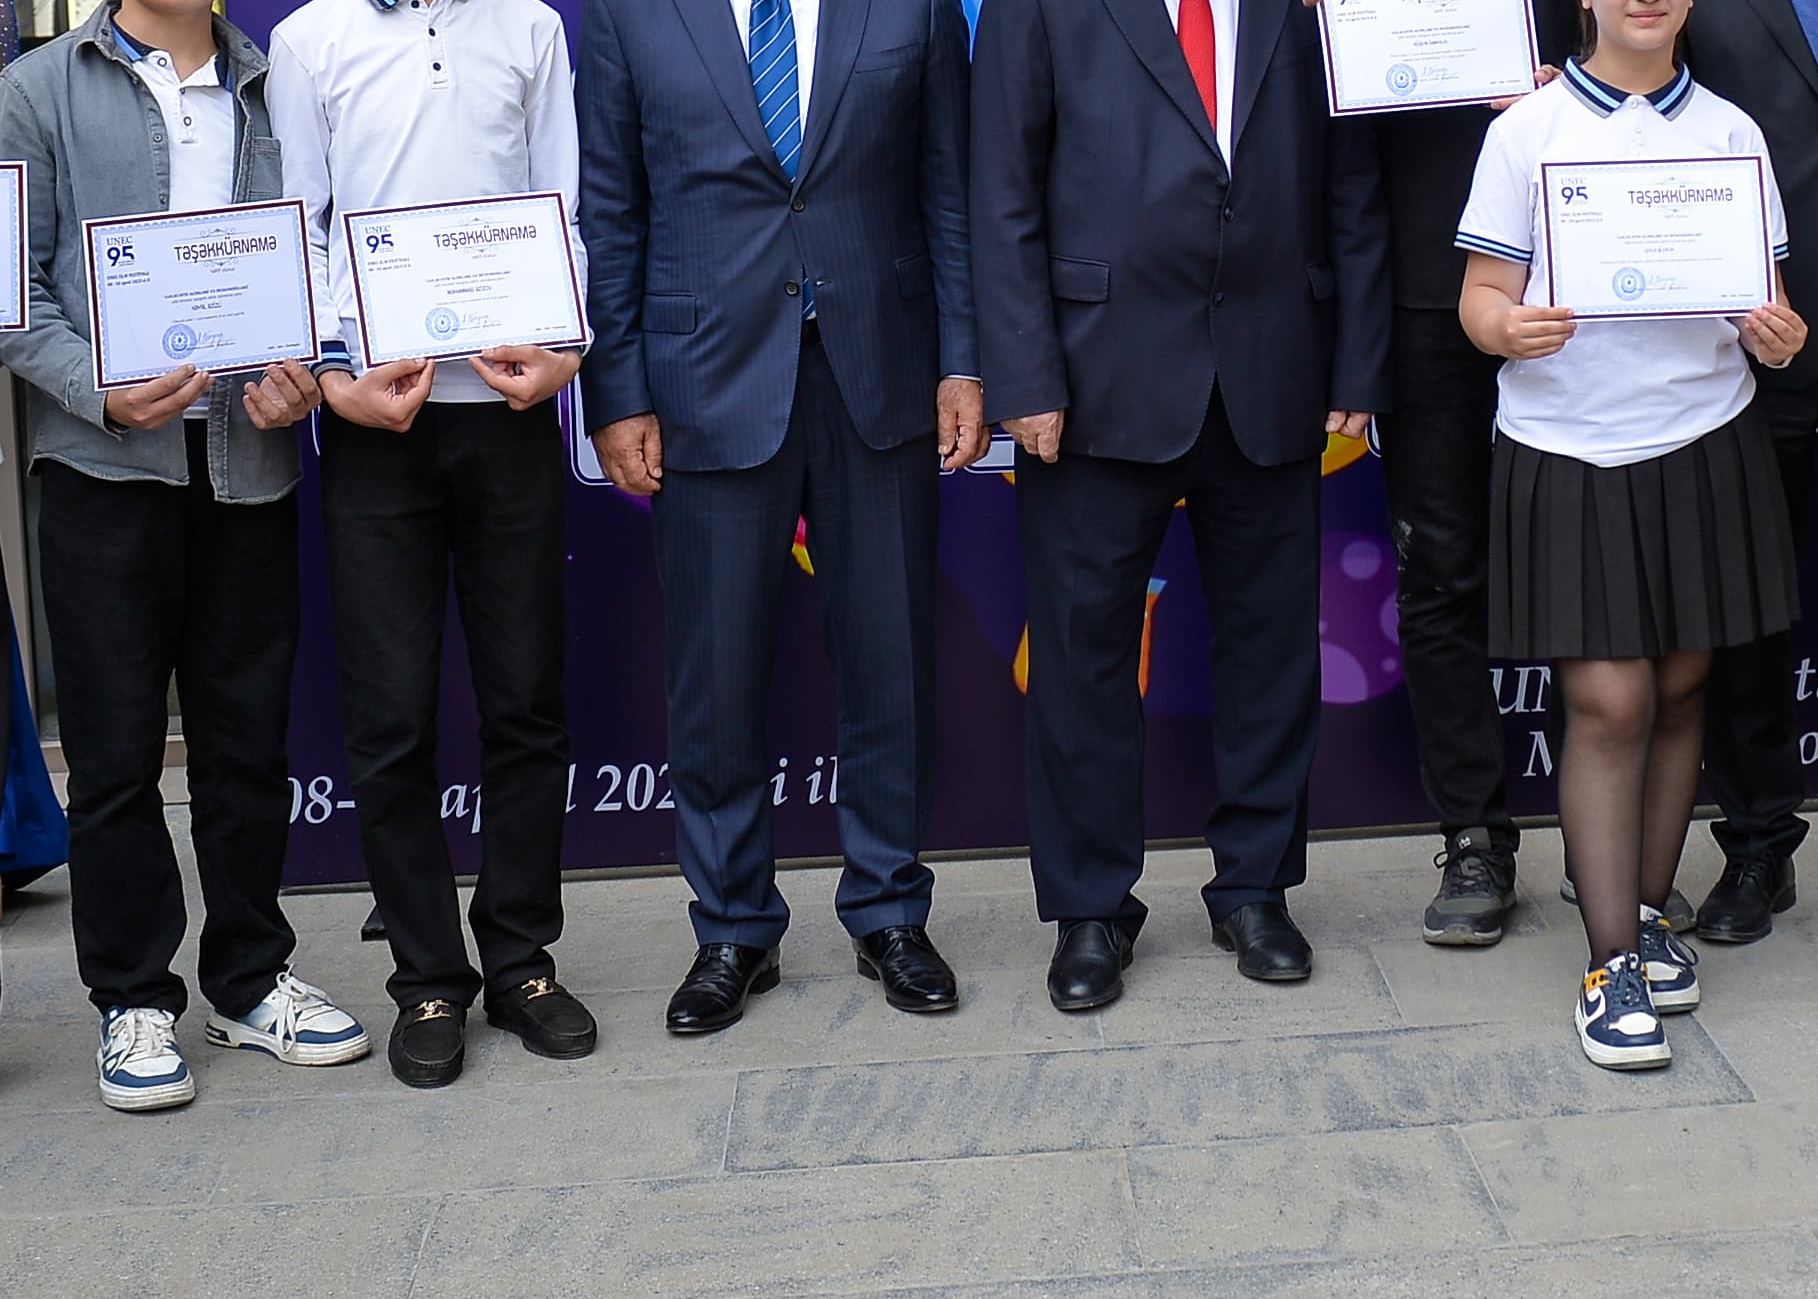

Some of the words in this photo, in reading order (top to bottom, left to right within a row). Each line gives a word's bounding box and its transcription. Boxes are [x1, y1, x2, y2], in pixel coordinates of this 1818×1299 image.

[1561, 186, 1588, 205] 95
[1628, 185, 1733, 208] TƏŞƏKKÜRNAMƏ
[106, 235, 133, 247] UNEC
[174, 232, 277, 264] TƏŞƏKKÜRNAMƏ
[366, 233, 394, 254] 95
[433, 224, 537, 250] TƏŞƏKKÜRNAMƏ
[106, 244, 135, 267] 95
